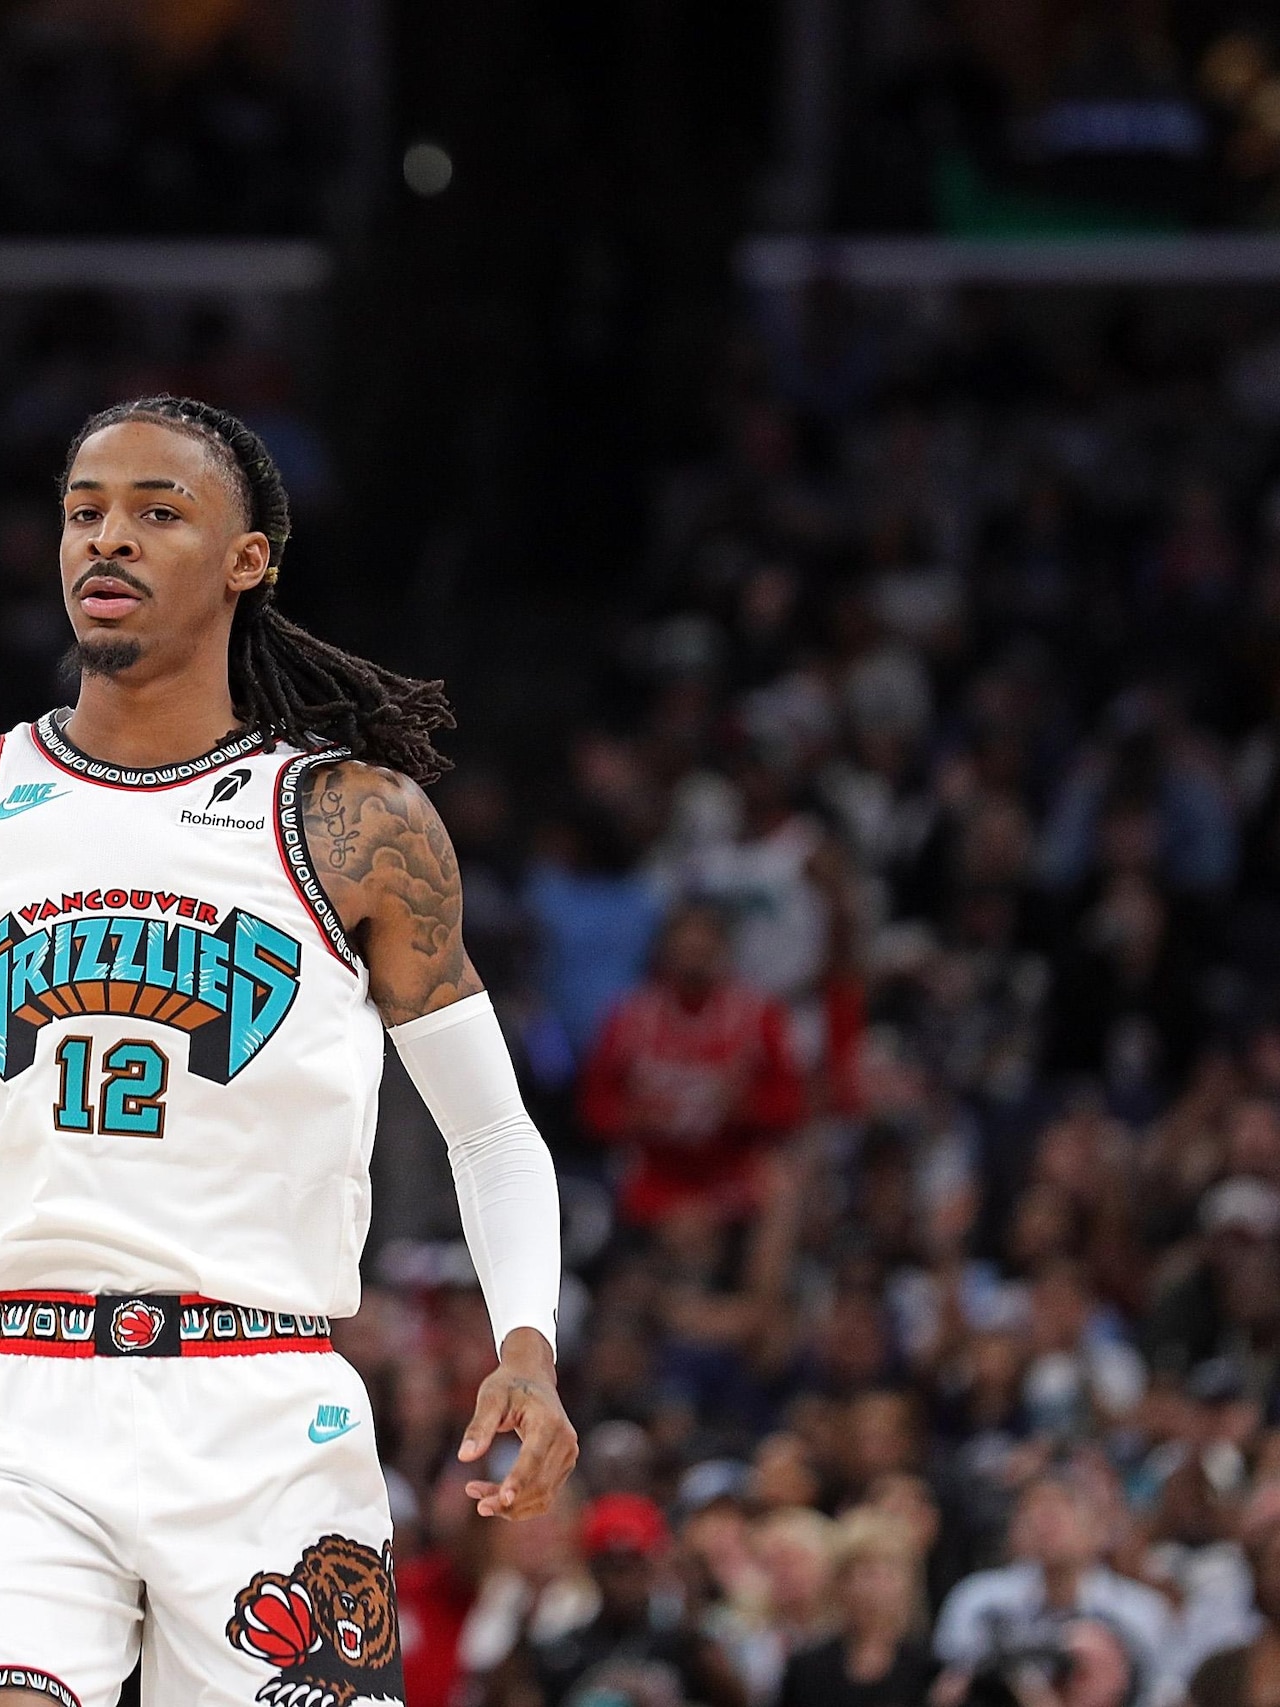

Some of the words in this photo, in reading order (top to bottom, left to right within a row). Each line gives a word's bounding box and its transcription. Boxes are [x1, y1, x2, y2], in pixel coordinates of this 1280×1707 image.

[6, 782, 57, 803] NIKE
[180, 809, 265, 830] Robinhood
[18, 888, 219, 926] VANCOUVER
[53, 1034, 170, 1139] 12
[316, 1404, 351, 1429] NIKE
